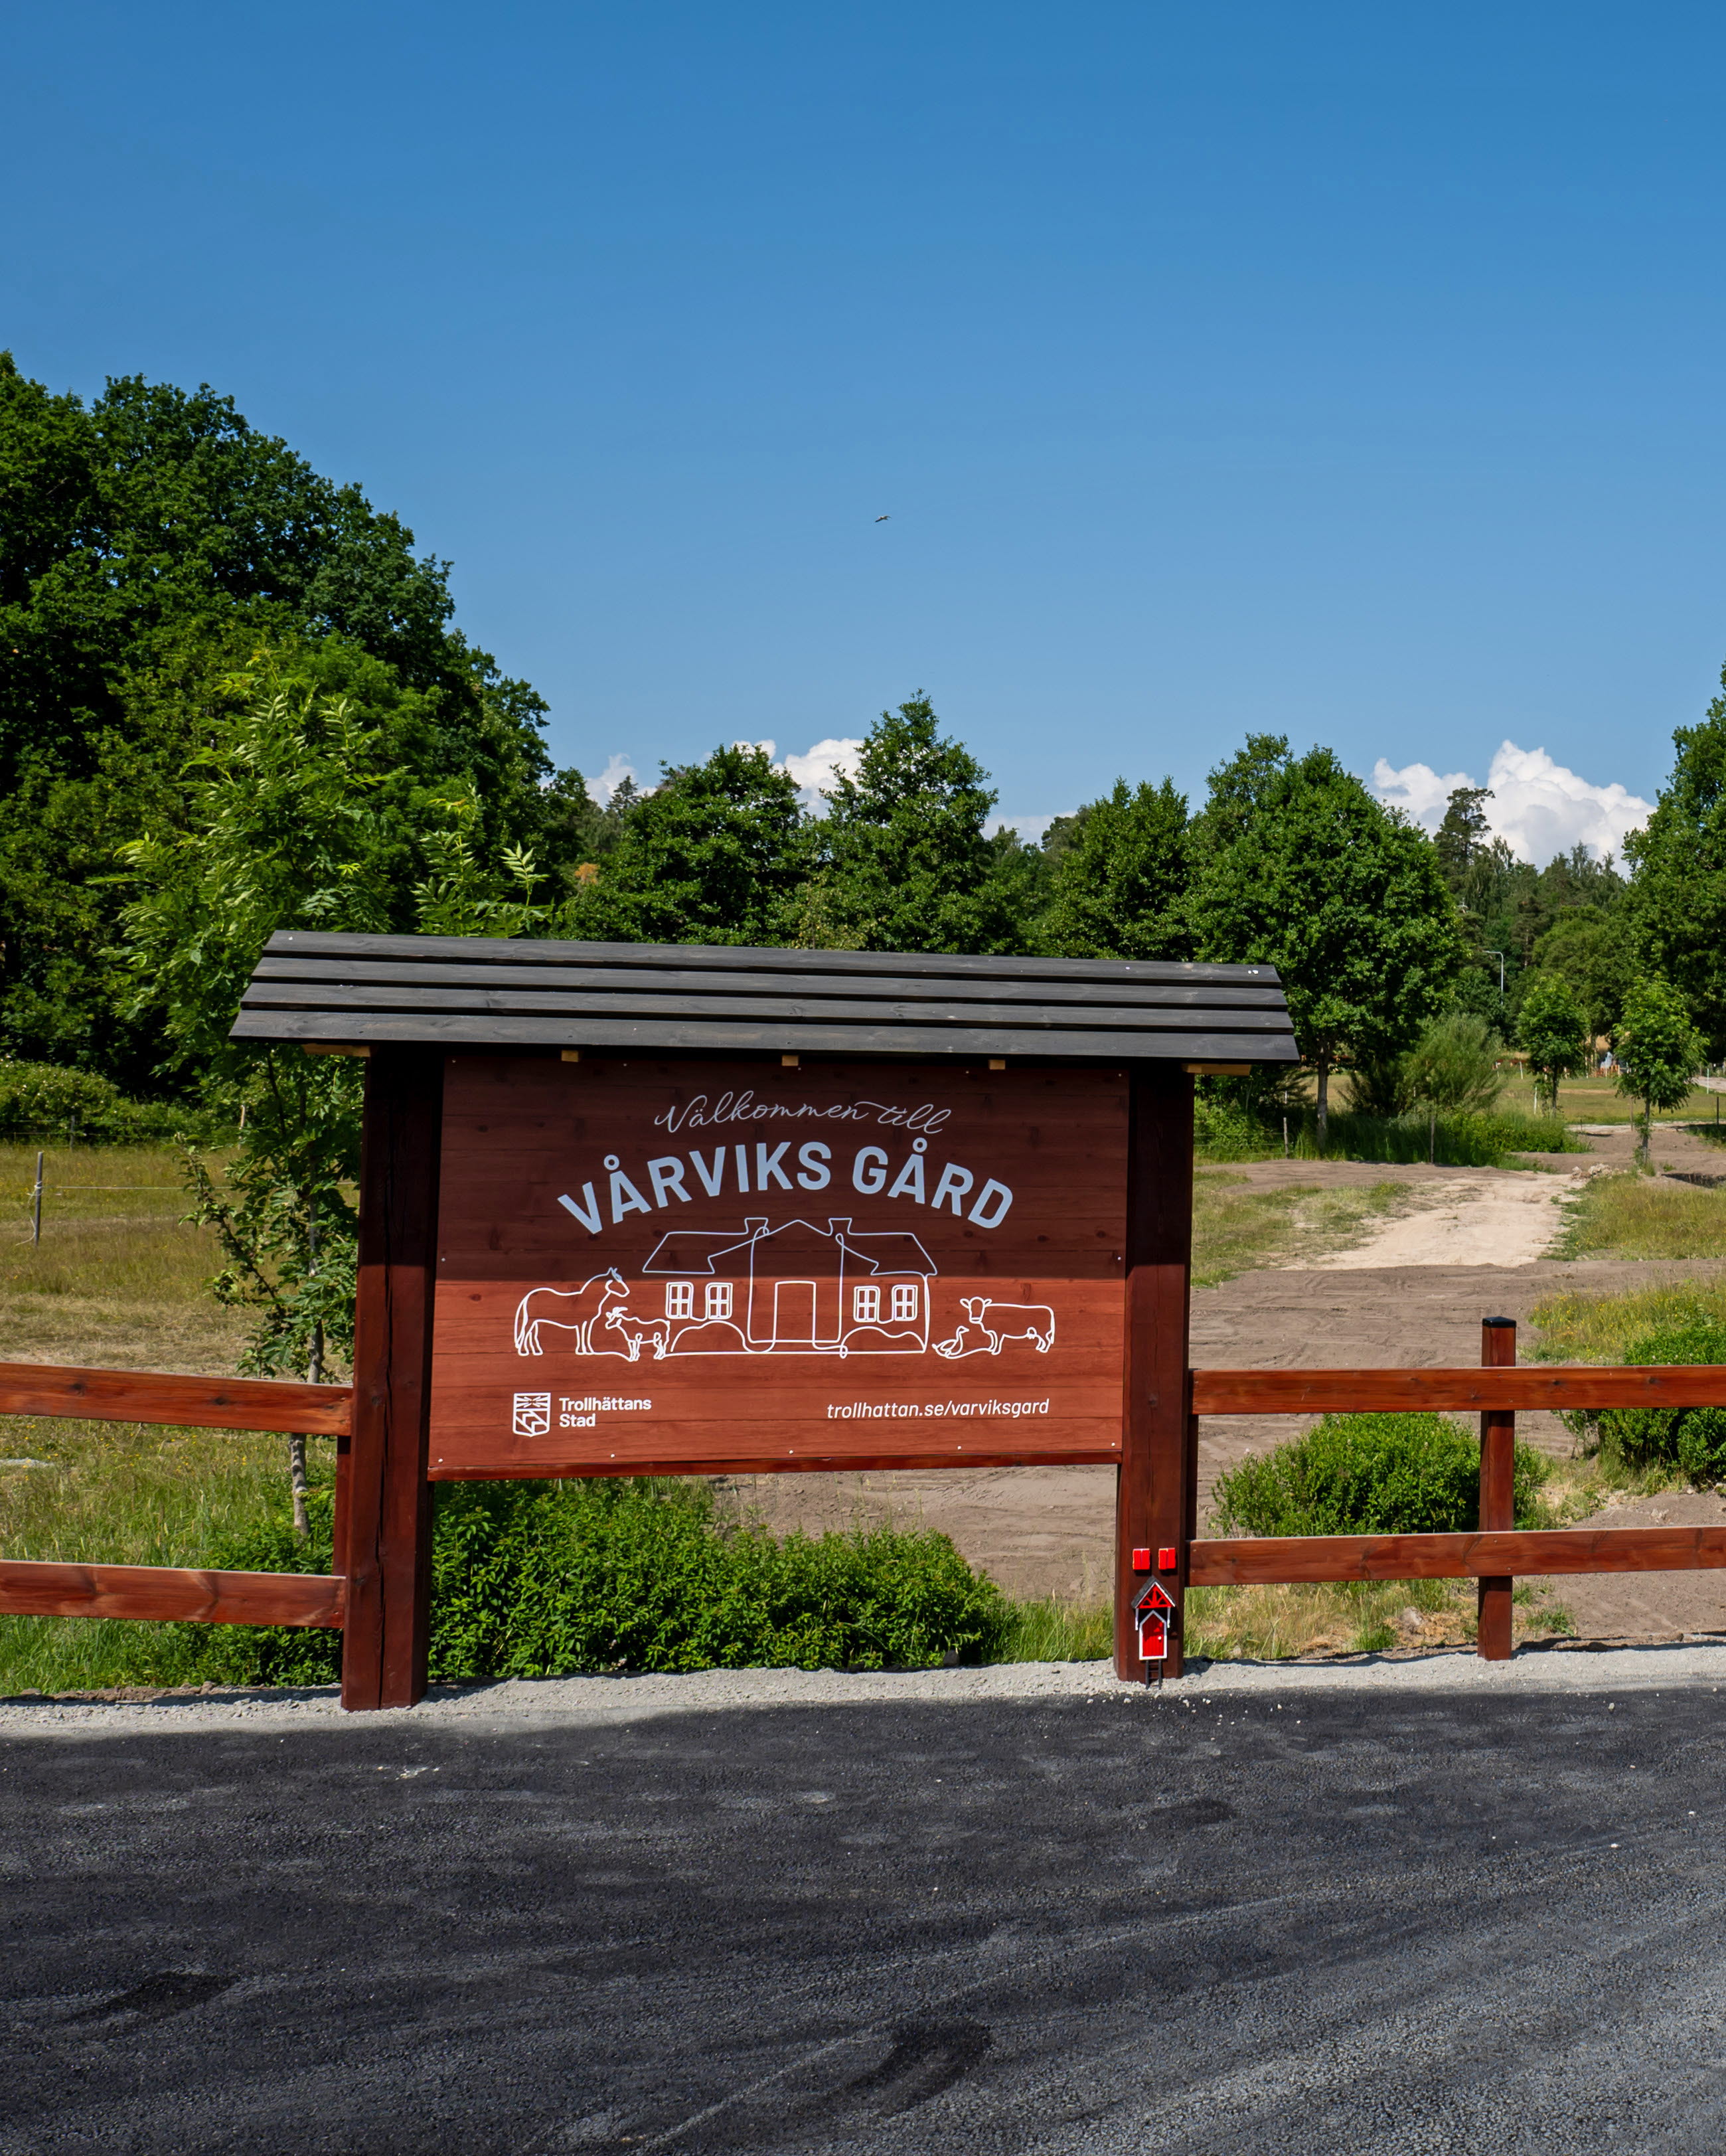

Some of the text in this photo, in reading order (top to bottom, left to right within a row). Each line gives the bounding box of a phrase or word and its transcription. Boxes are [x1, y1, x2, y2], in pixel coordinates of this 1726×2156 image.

[654, 1090, 952, 1134] Välkommen till
[557, 1137, 1014, 1234] VÅRVIKS GÅRD
[558, 1396, 652, 1412] Trollhättans
[826, 1398, 1050, 1419] trollhattan.se/varviksgard
[559, 1412, 596, 1428] Stad
